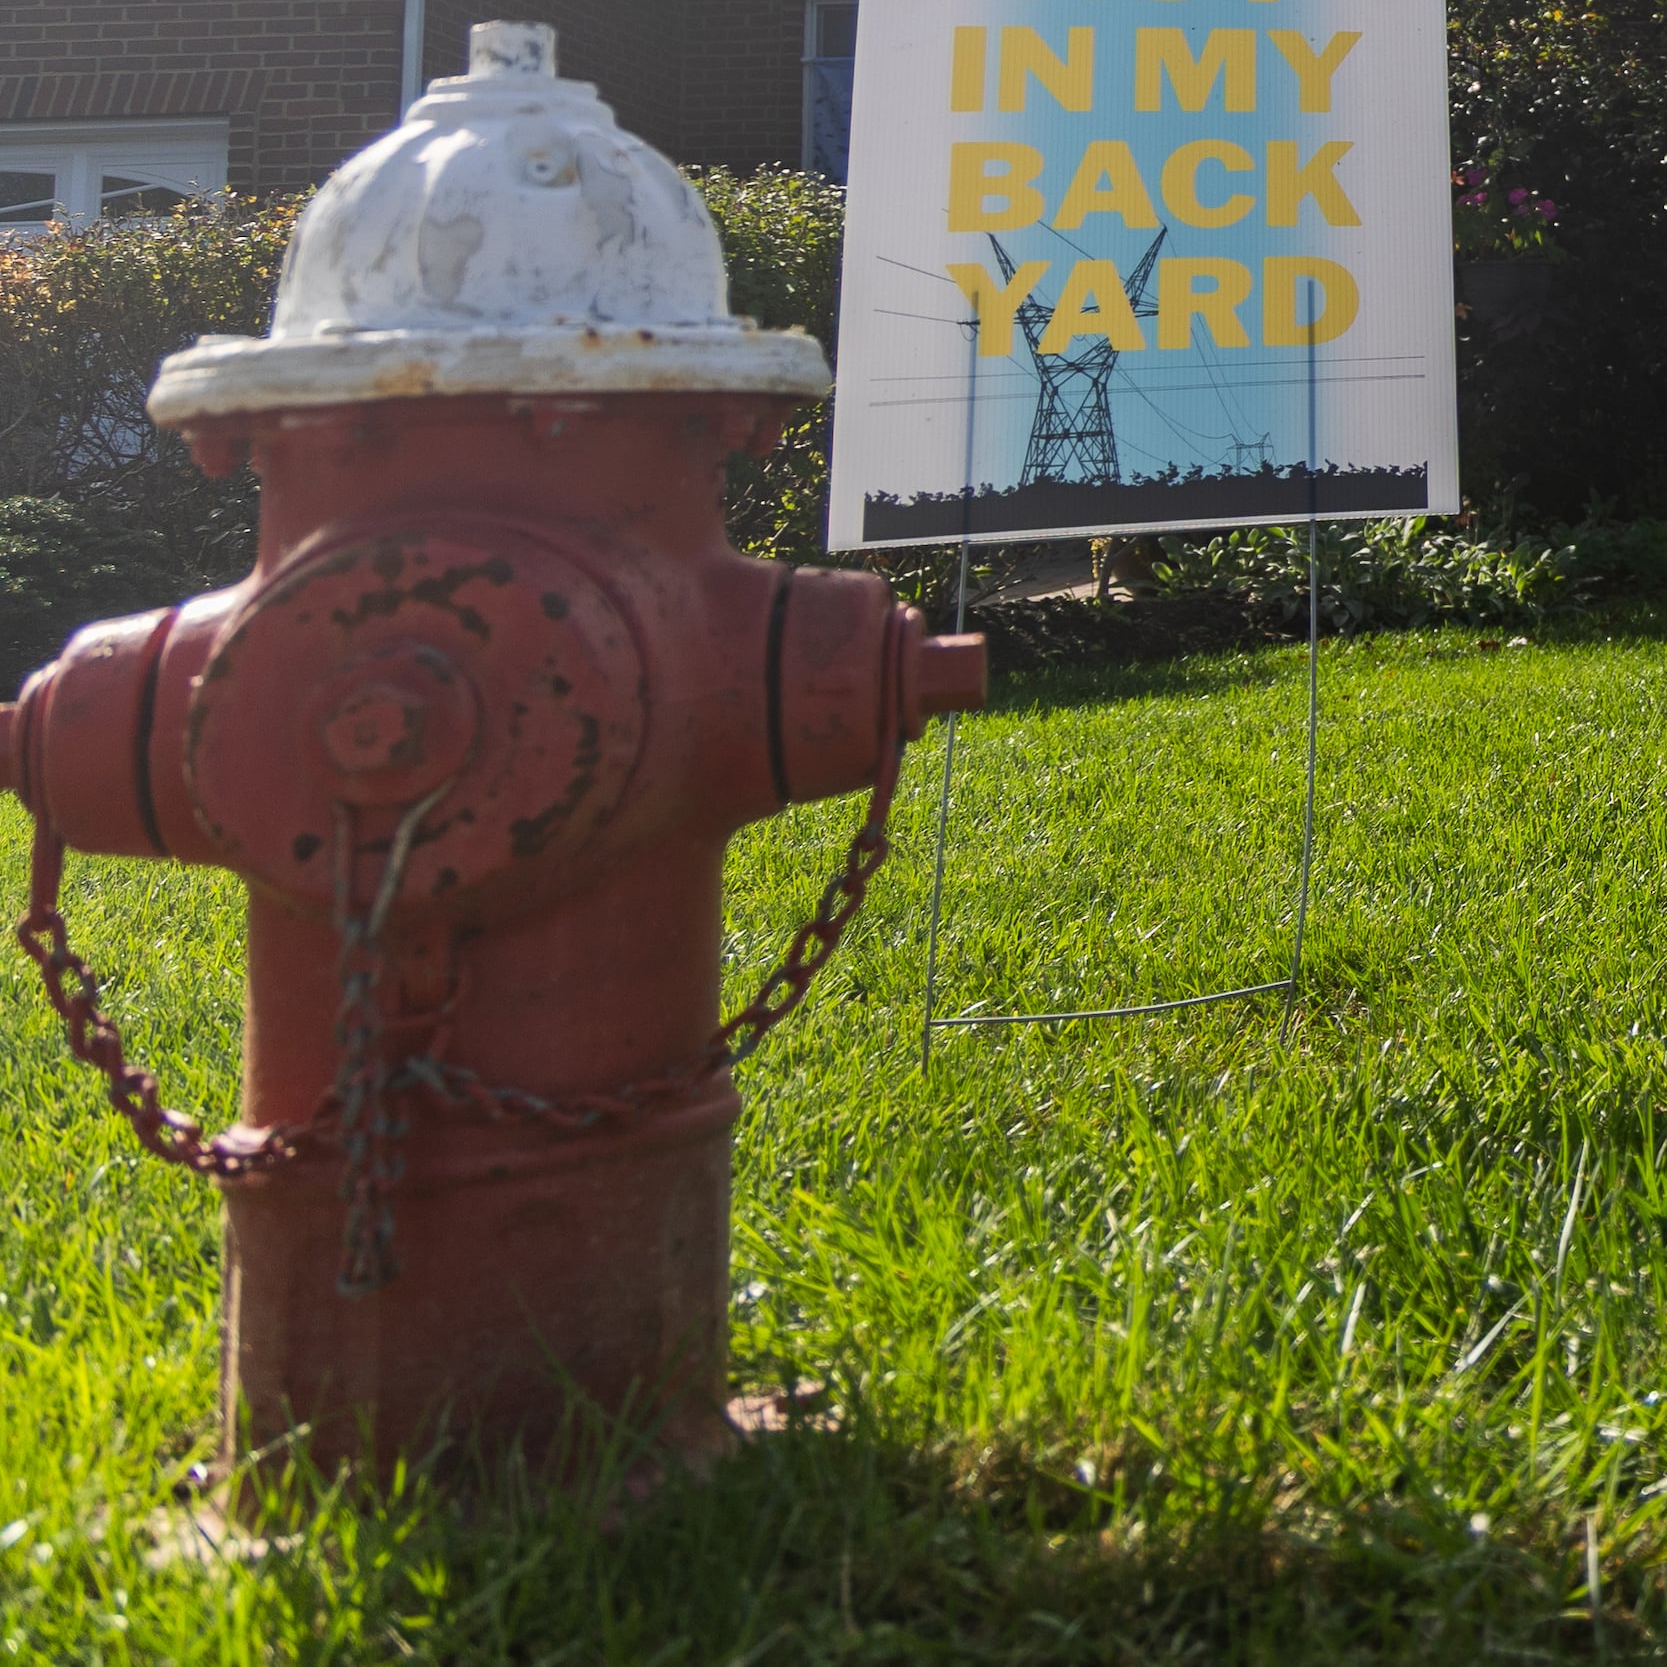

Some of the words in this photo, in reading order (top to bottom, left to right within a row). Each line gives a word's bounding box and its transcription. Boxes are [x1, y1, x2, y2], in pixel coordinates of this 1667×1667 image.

[950, 25, 1095, 113] IN
[1134, 26, 1363, 114] MY
[946, 139, 1364, 233] BACK
[945, 255, 1361, 358] YARD
